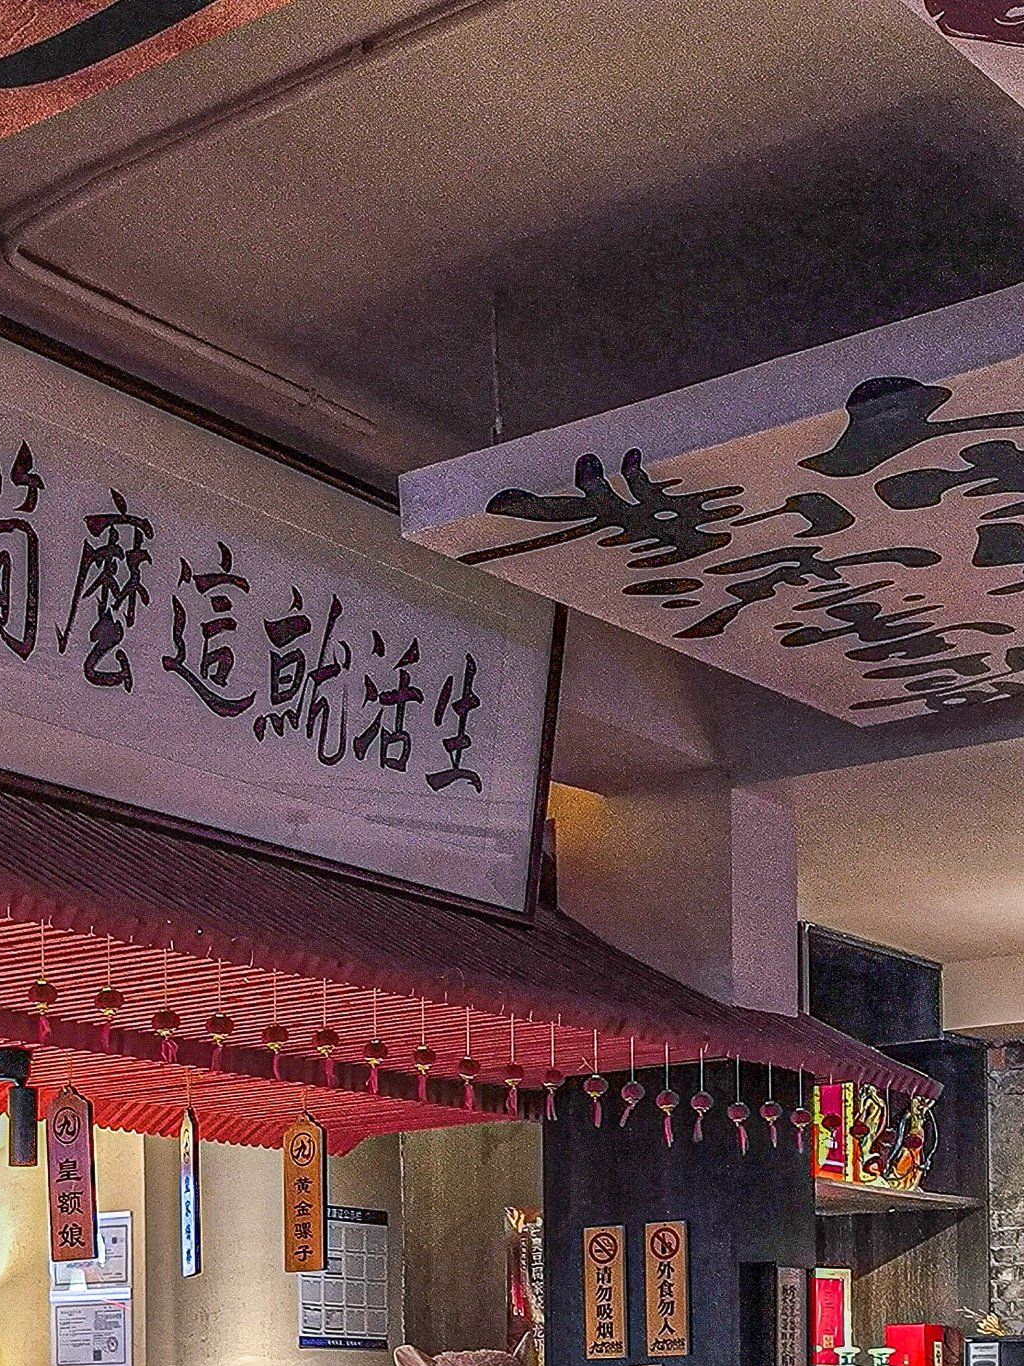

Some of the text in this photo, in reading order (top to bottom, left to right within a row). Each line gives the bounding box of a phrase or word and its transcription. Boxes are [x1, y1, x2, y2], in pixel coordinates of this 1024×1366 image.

[55, 1157, 86, 1248] 皇额娘
[293, 1176, 313, 1263] 黄金骡子
[595, 1266, 614, 1339] 请勿吸烟
